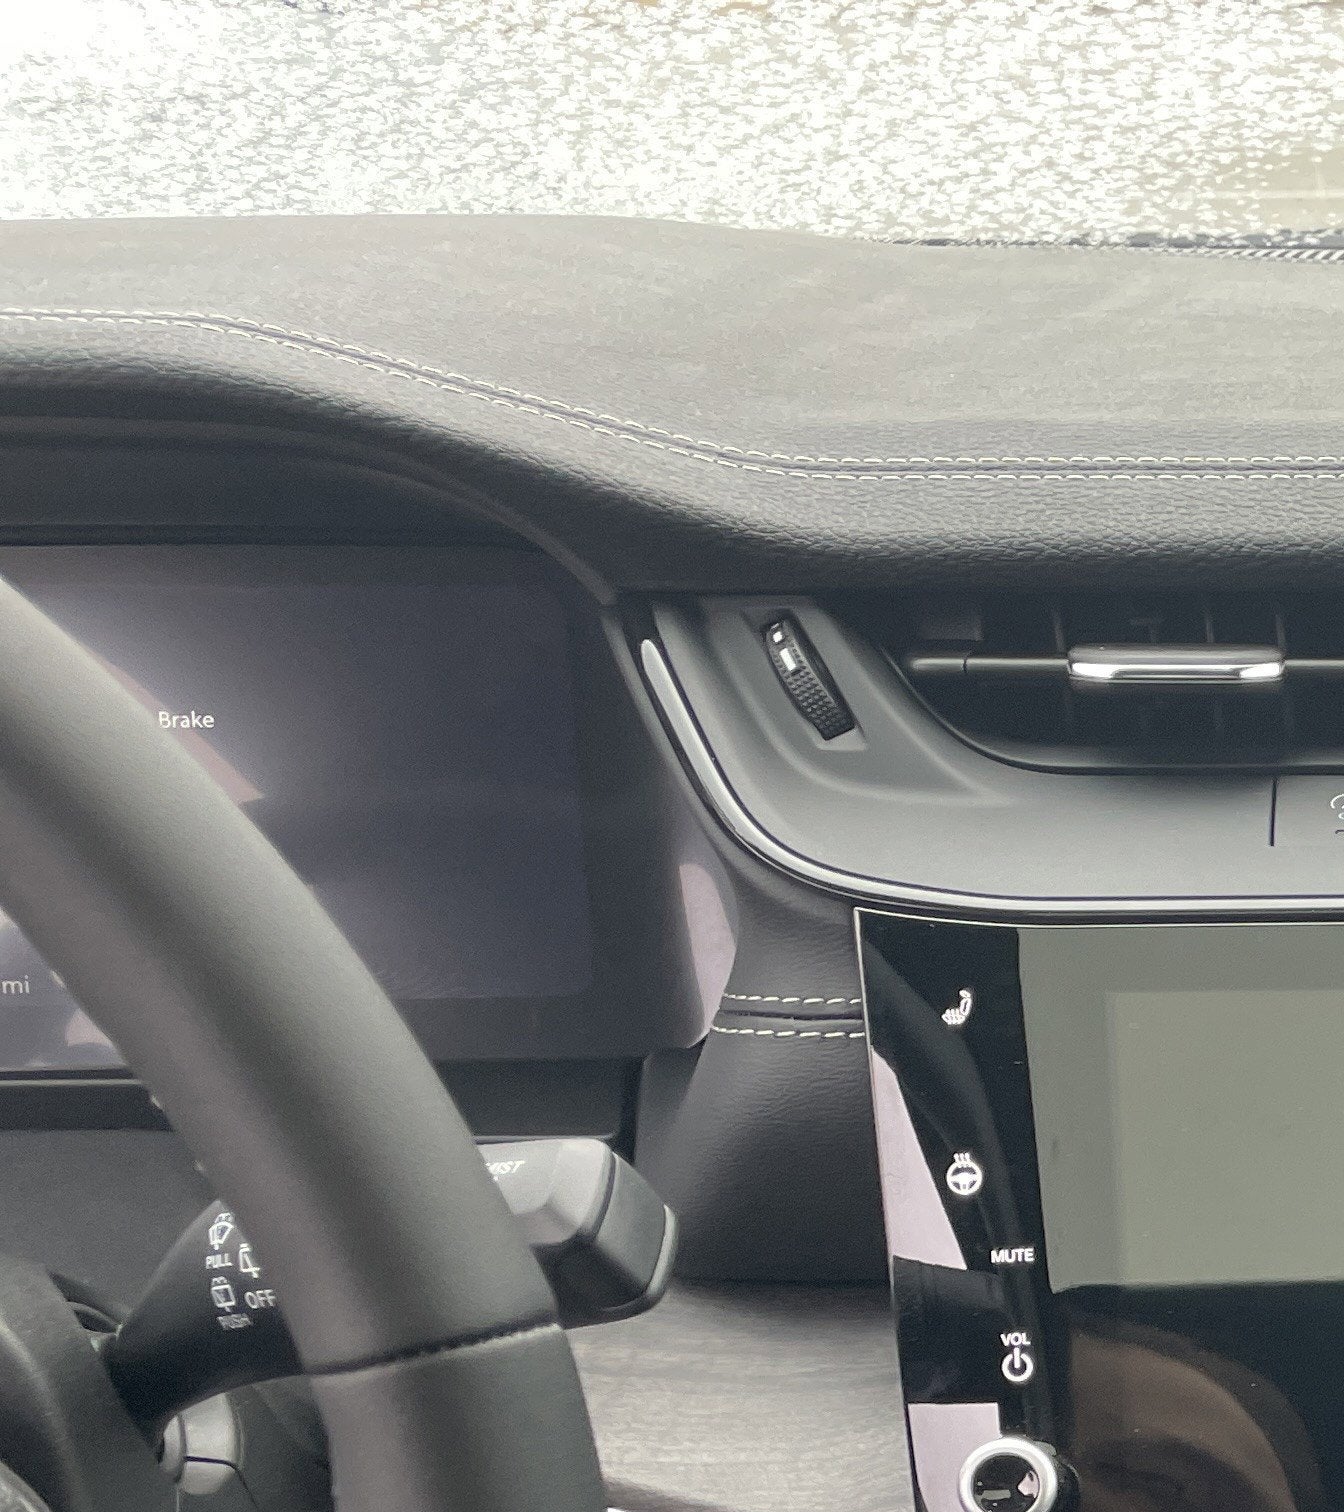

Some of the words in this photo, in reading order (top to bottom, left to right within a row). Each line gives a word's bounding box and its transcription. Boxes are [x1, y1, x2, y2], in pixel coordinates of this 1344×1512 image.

[158, 710, 215, 729] Brake
[1, 974, 30, 994] mi
[991, 1248, 1034, 1264] MUTE
[244, 1289, 277, 1309] OFF
[1001, 1333, 1030, 1347] VOL
